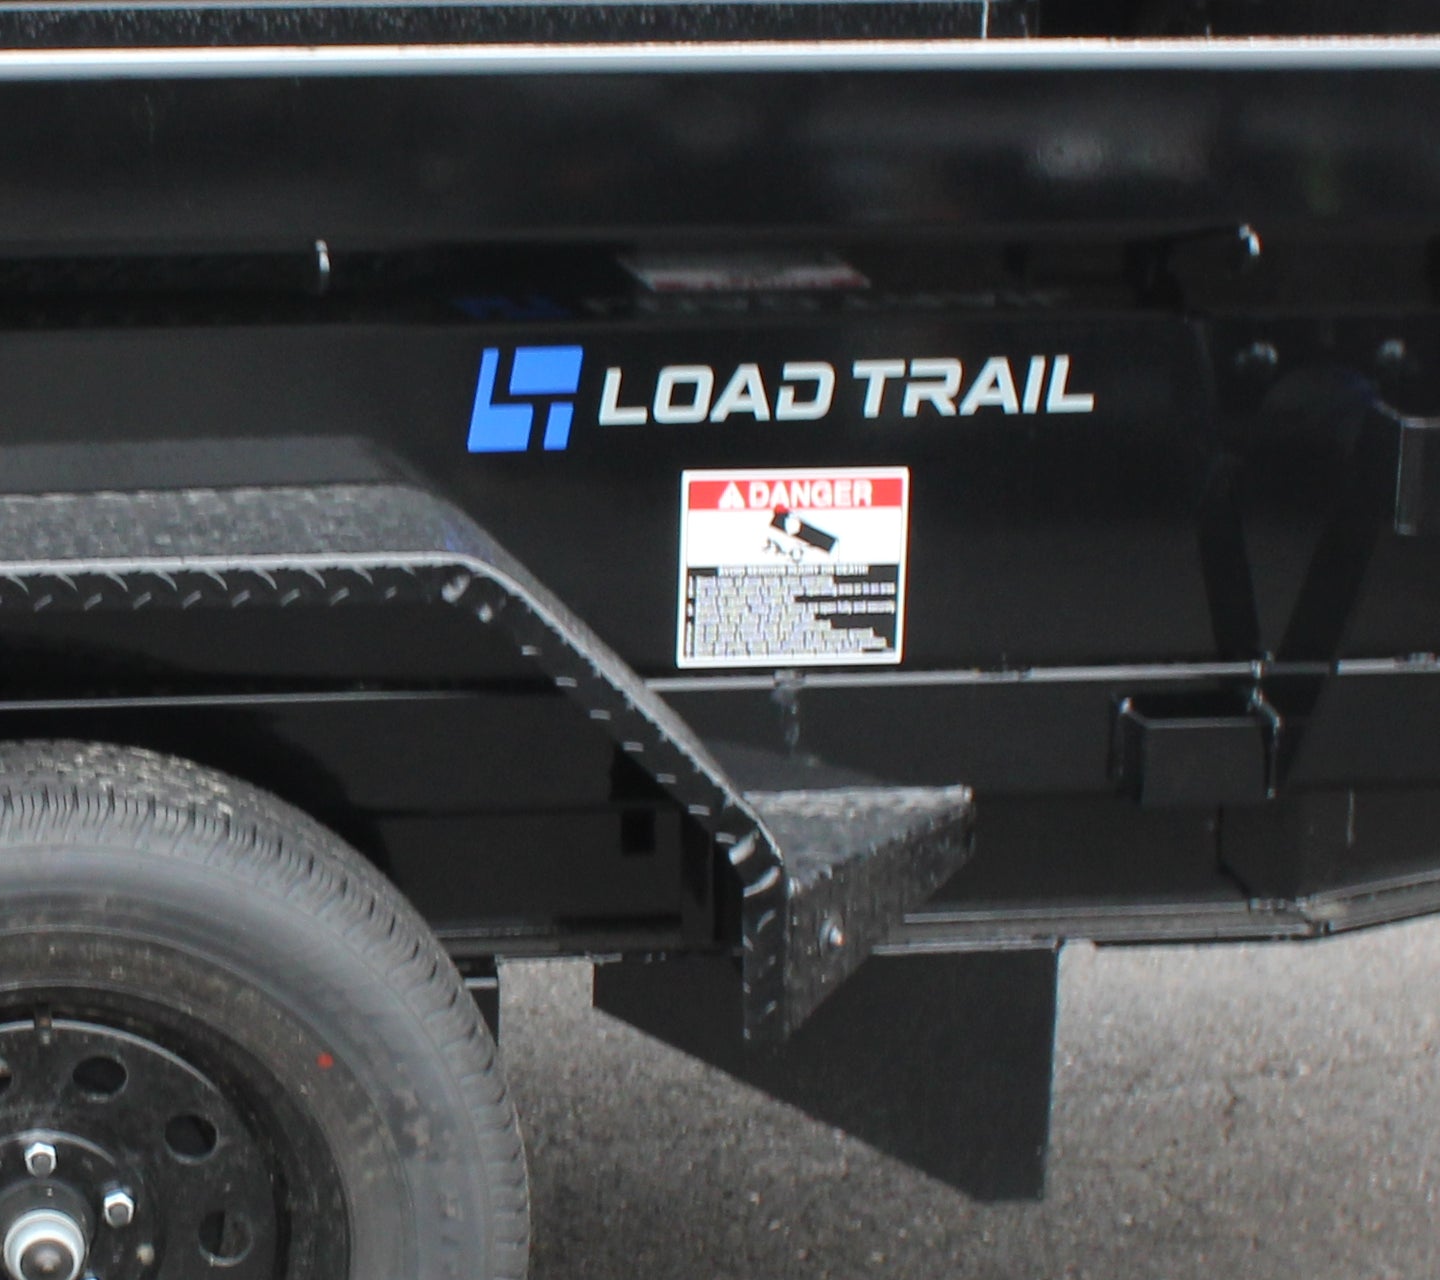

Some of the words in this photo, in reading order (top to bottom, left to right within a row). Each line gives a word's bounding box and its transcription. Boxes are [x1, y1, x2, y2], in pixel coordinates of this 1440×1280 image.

[599, 360, 836, 426] LOAD
[852, 354, 1095, 419] TRAIL
[748, 479, 873, 509] DANGER
